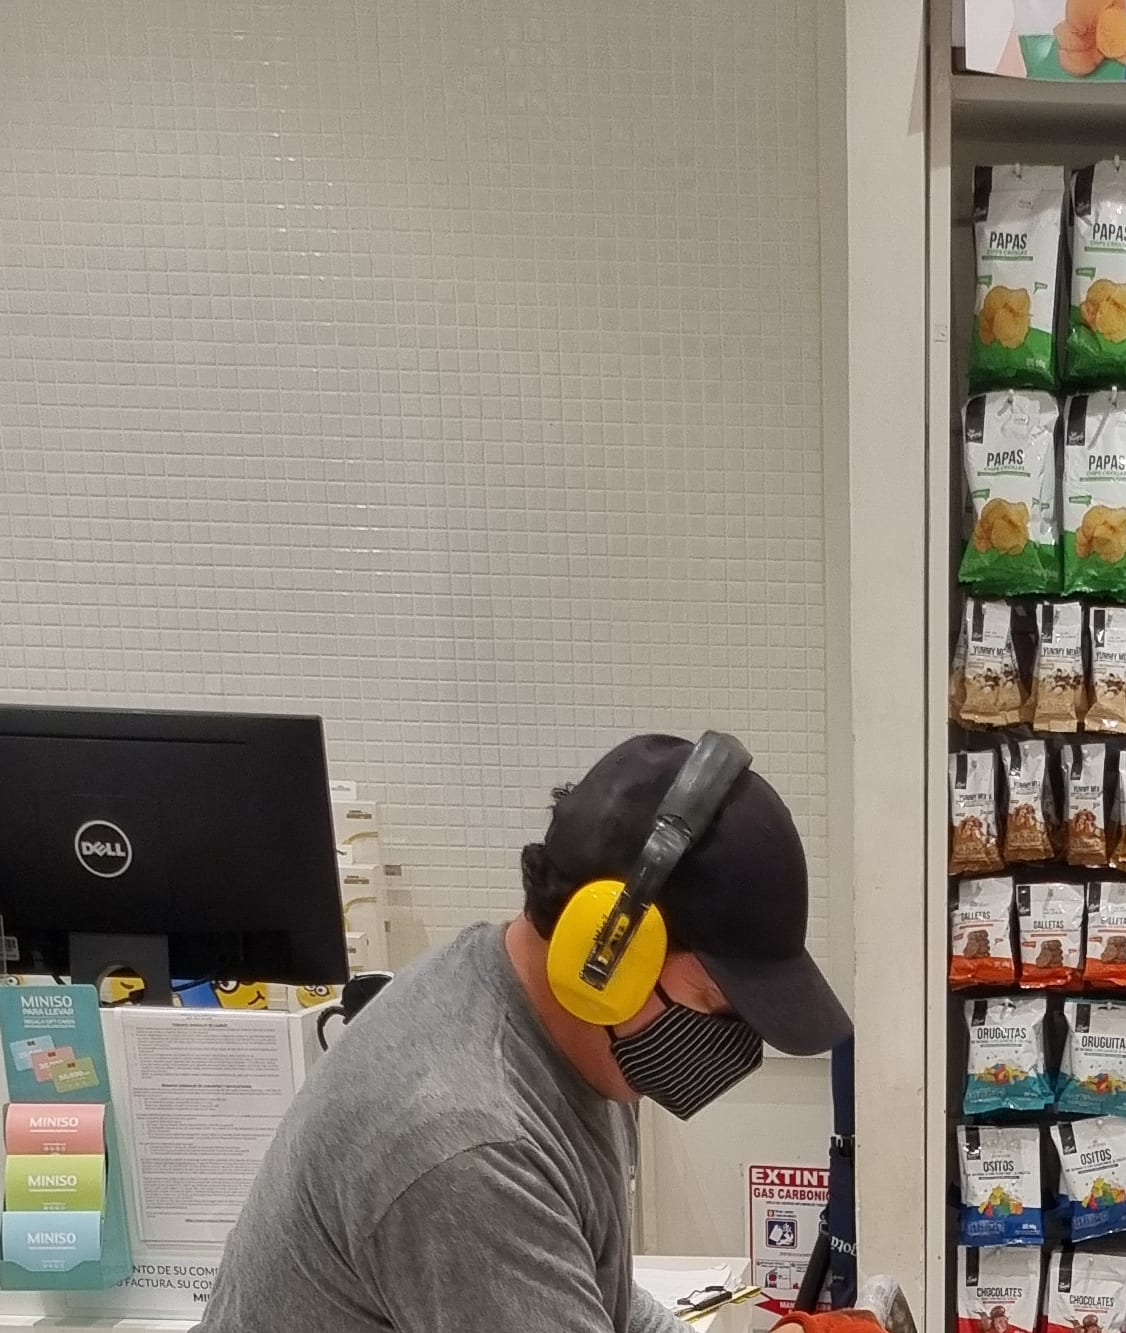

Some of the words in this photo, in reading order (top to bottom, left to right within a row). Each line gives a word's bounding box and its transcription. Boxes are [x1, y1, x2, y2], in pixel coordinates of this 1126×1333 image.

[989, 231, 1028, 250] PAPAS
[987, 449, 1025, 466] PAPAS
[1088, 454, 1126, 471] PAPAS
[80, 841, 126, 856] DELL
[961, 911, 991, 921] GALLETAS
[1033, 920, 1065, 929] GALLETAS
[21, 995, 73, 1008] MINISO
[45, 1008, 74, 1016] LLEVAR
[977, 1027, 1027, 1040] ORUGUITAS
[29, 1117, 79, 1128] MINISO
[1080, 1149, 1112, 1165] OSITOS
[983, 1160, 1015, 1173] OSITOS
[28, 1175, 77, 1187] MINISO
[753, 1187, 775, 1199] GAS
[27, 1232, 76, 1244] MINISO
[158, 1266, 171, 1275] DE
[173, 1266, 187, 1276] SU
[177, 1280, 190, 1289] SU
[977, 1287, 1023, 1299] CHOCOLATES
[1069, 1294, 1114, 1309] CHOCOLATES
